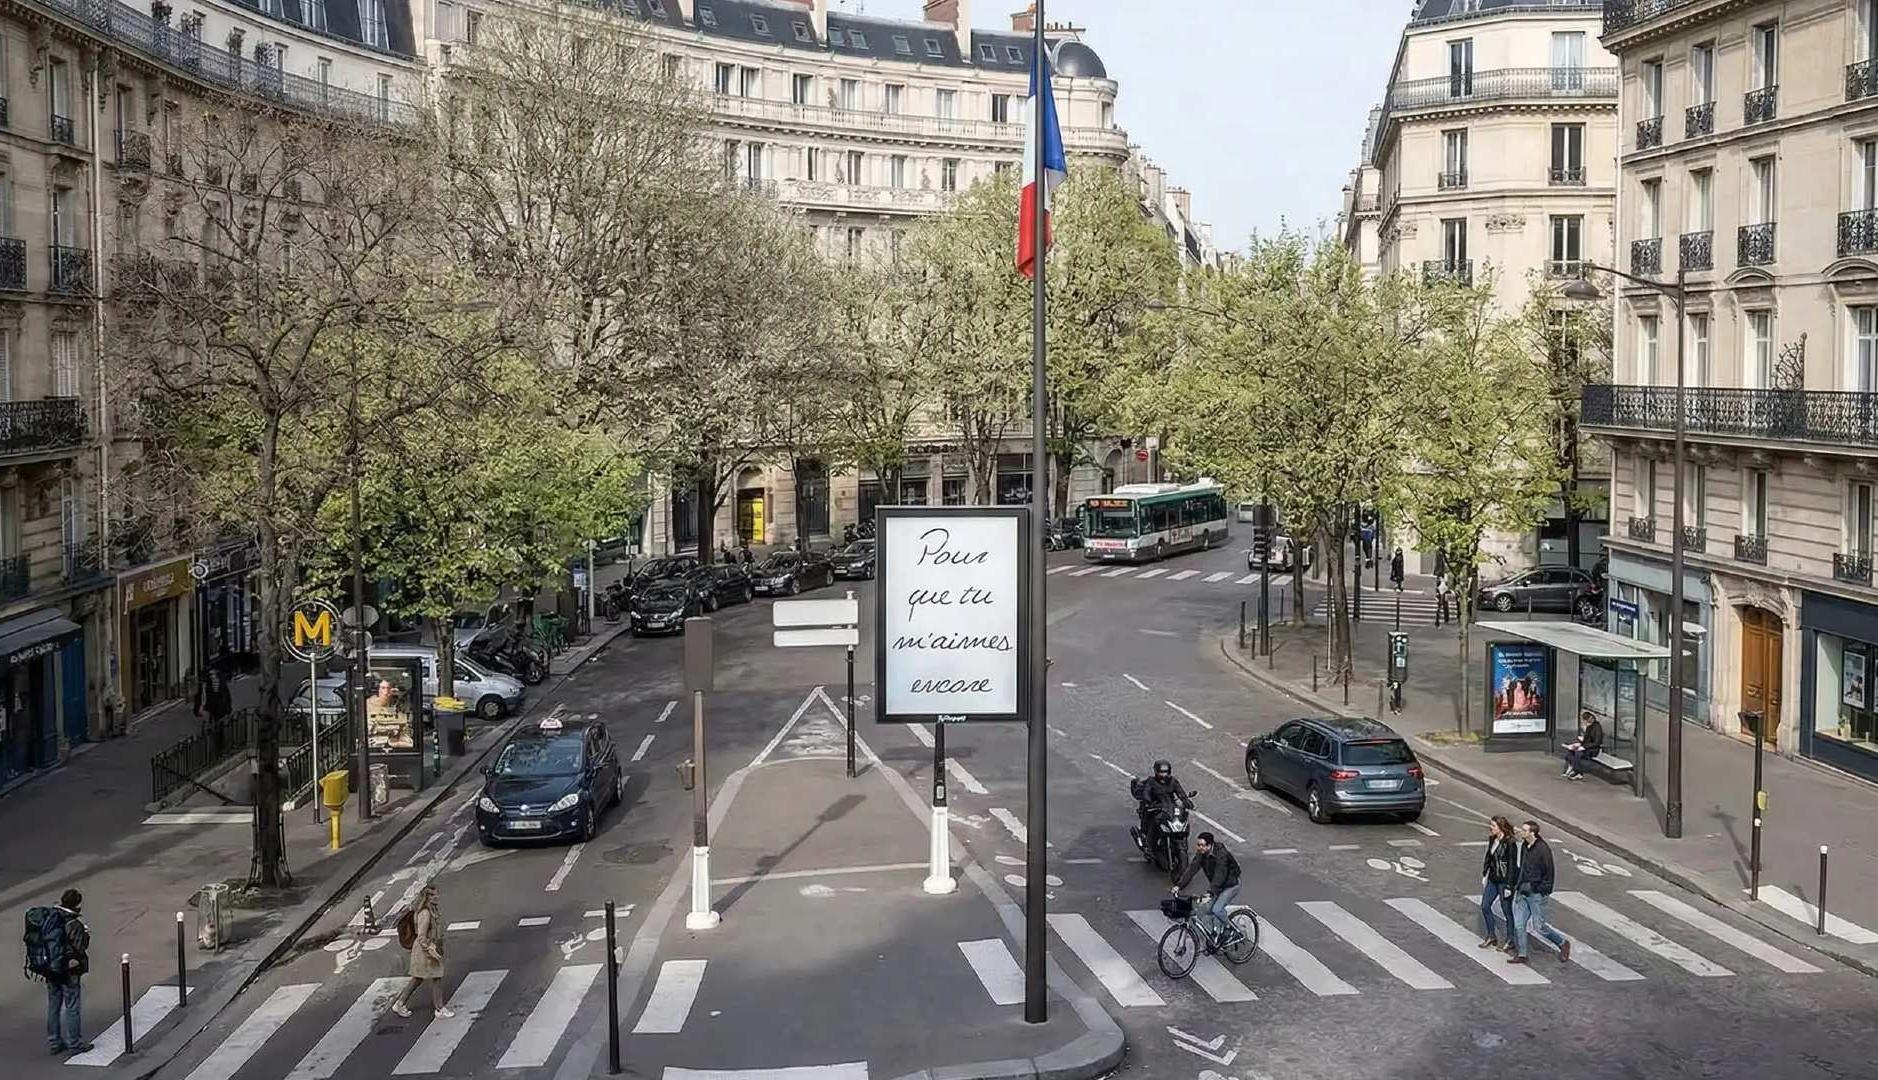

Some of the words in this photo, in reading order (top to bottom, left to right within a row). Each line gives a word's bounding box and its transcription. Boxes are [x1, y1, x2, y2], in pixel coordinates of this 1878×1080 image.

[917, 528, 989, 566] Pour
[908, 589, 953, 622] que
[959, 586, 994, 605] tu
[294, 610, 331, 646] M
[892, 633, 1014, 652] m'aimes
[910, 678, 993, 694] encore
